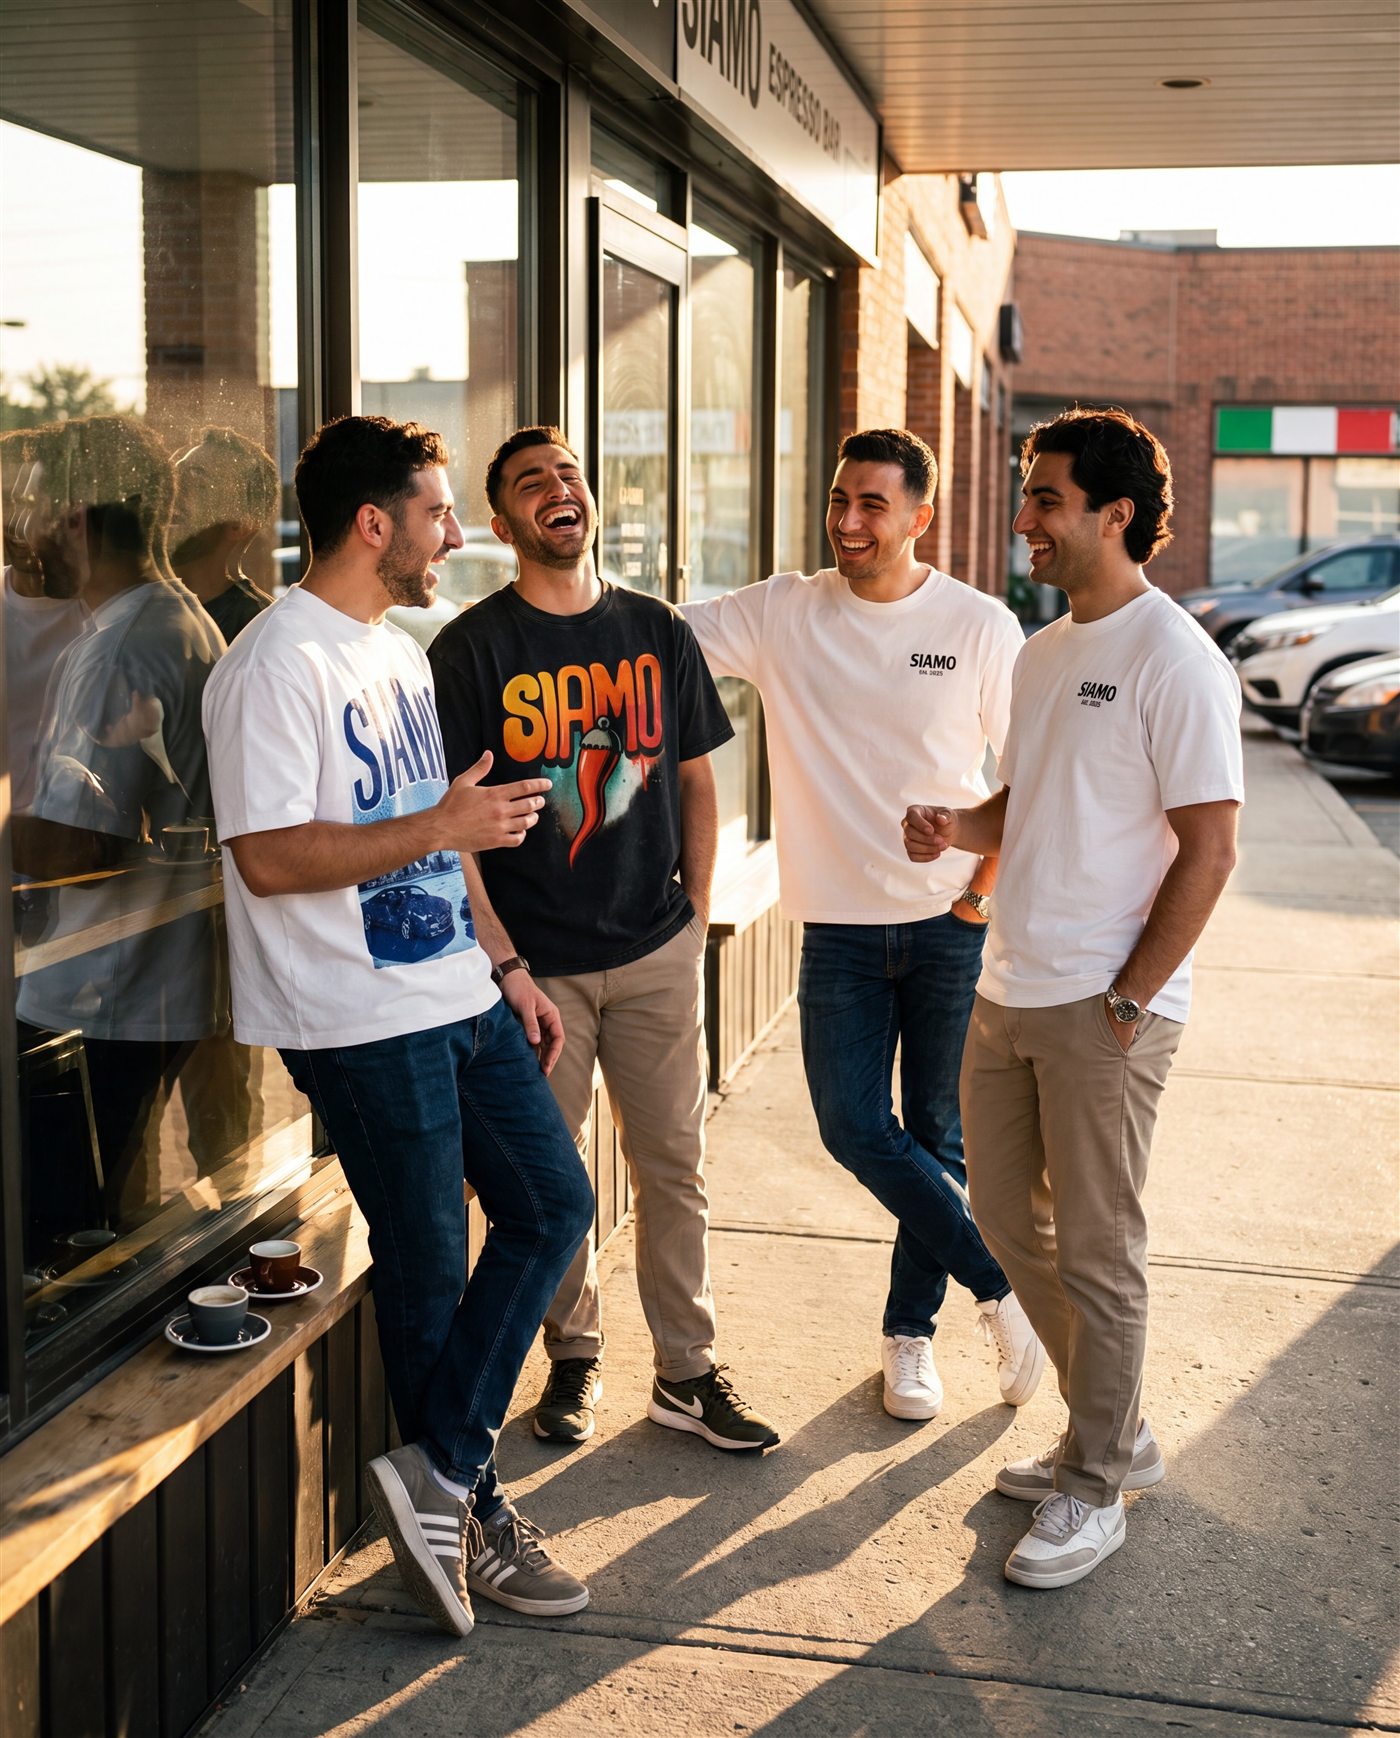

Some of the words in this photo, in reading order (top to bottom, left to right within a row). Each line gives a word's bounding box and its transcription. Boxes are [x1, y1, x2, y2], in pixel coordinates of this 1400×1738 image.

[768, 41, 821, 144] ESPRESSO
[823, 108, 840, 161] BAR
[910, 653, 957, 670] SIAMO
[1077, 681, 1117, 702] SIAMO
[502, 653, 663, 763] SIAMO
